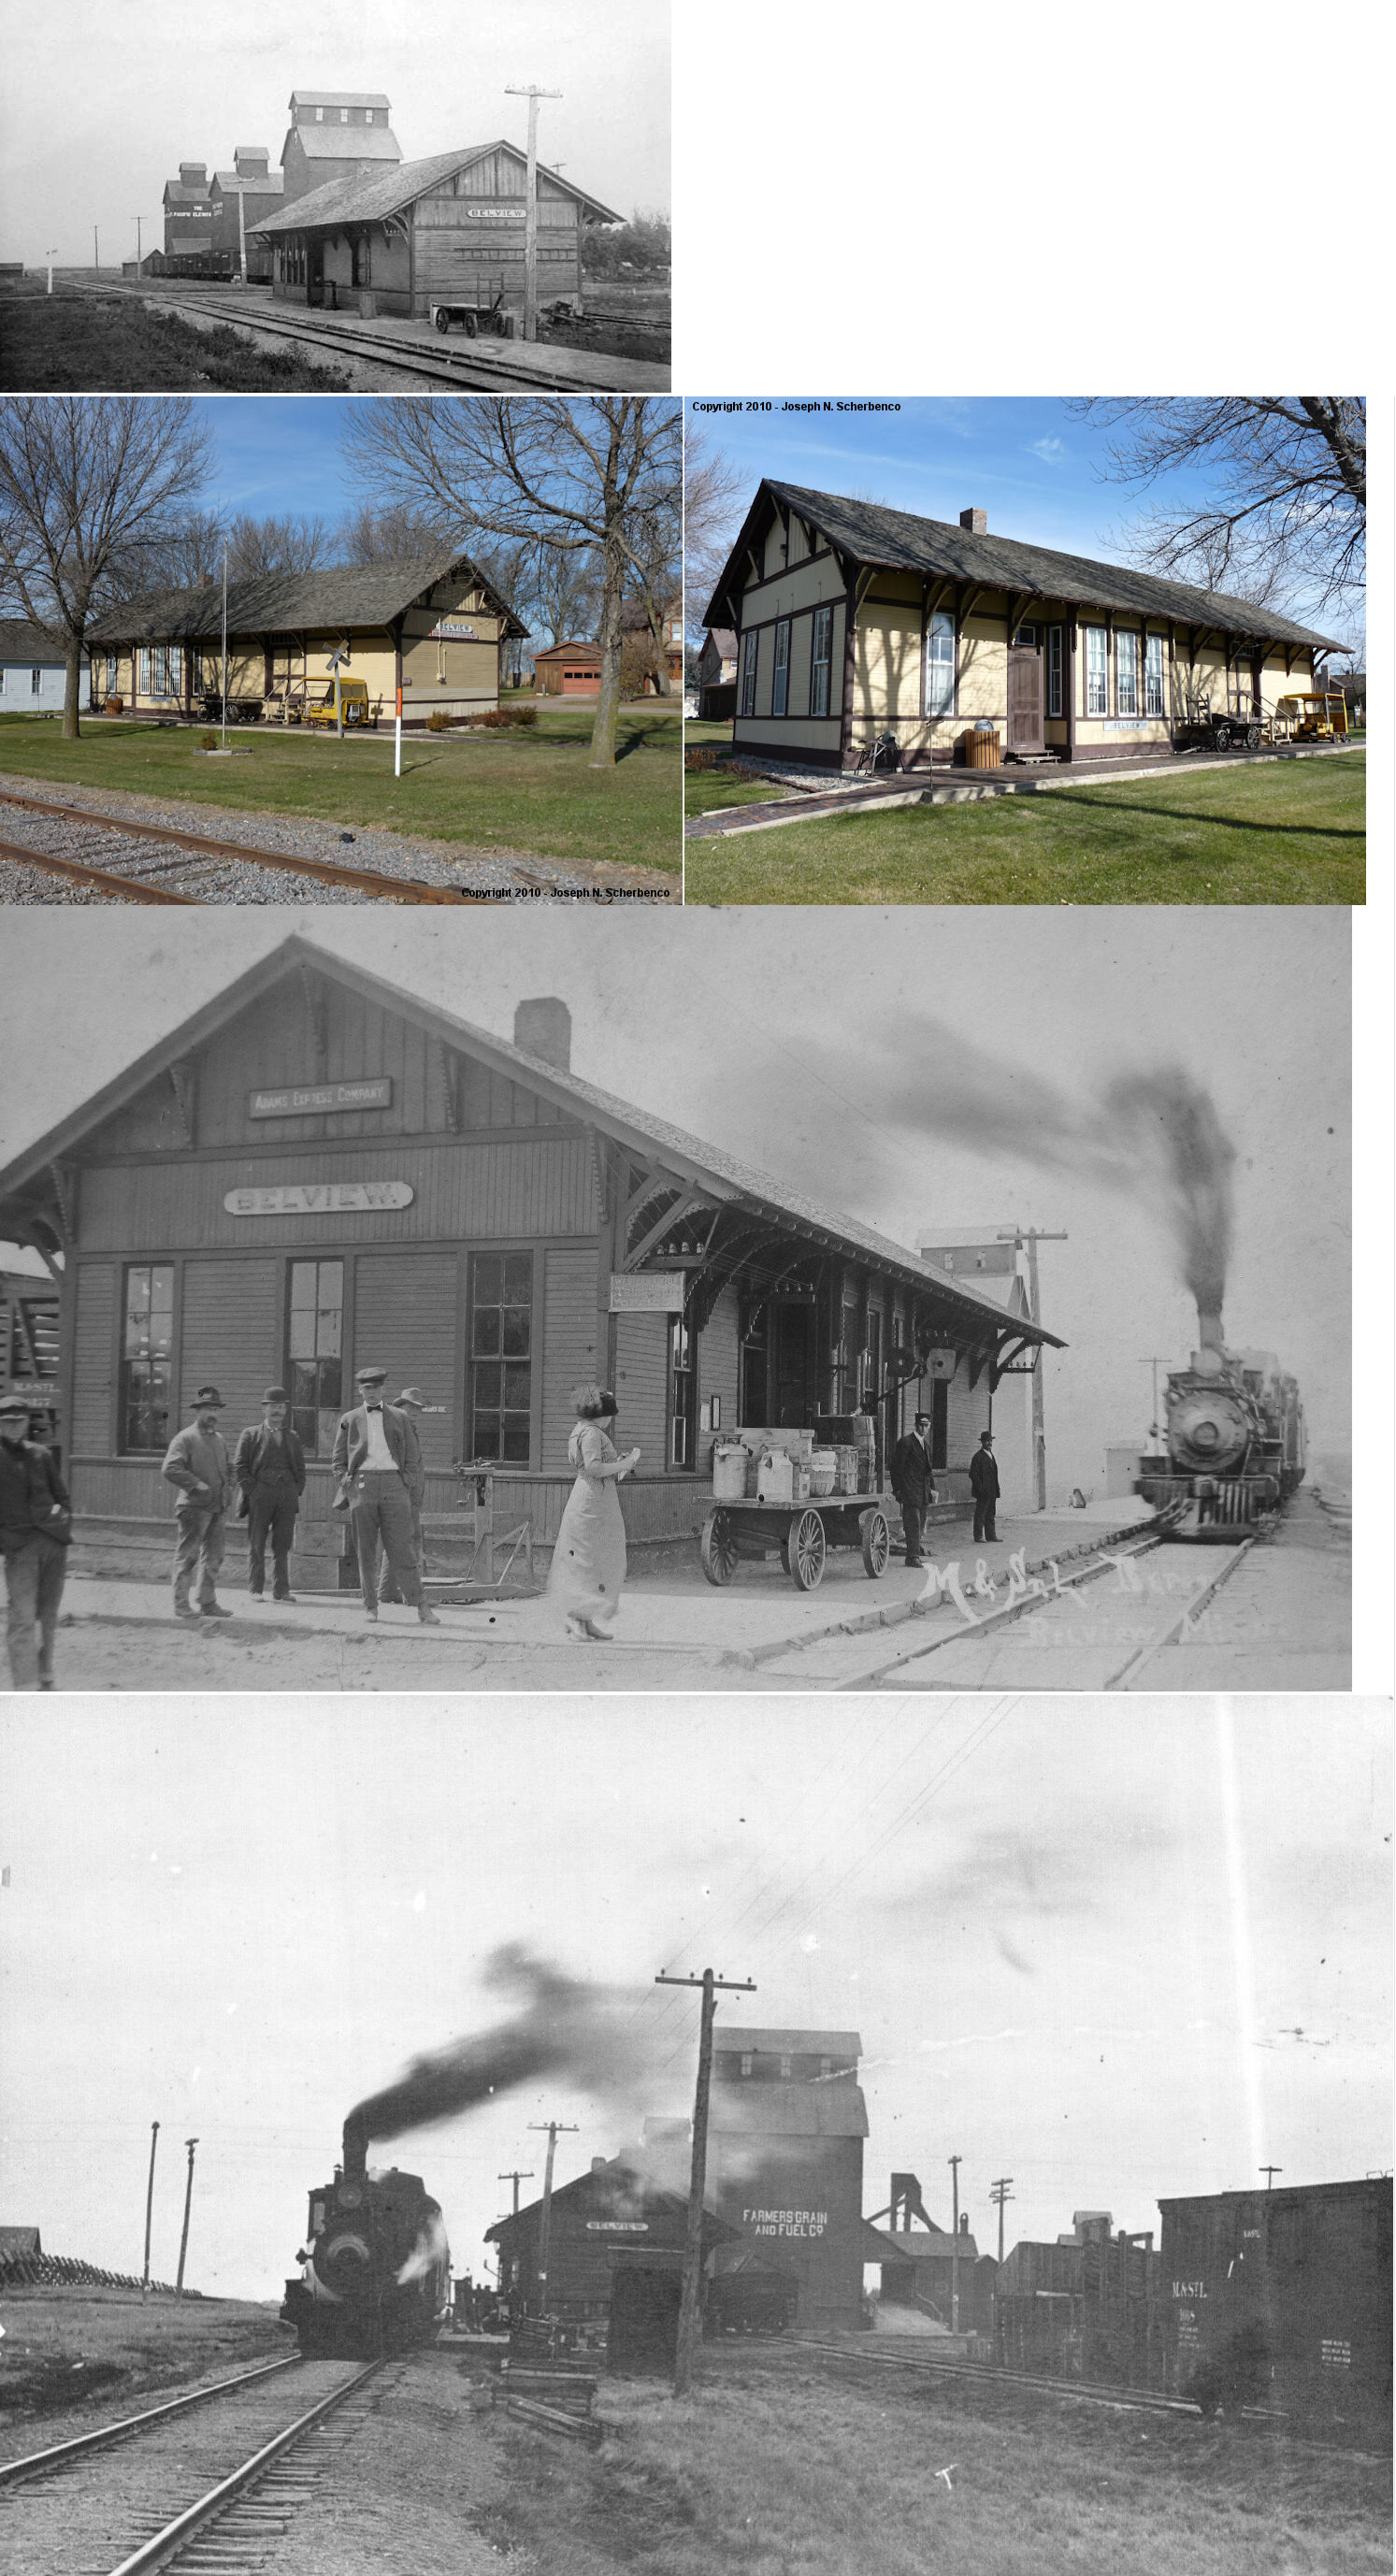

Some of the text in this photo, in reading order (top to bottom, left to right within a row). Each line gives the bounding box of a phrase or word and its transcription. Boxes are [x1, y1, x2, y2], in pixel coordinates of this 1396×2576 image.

[255, 1085, 384, 1110] ADAMS EXPRESS COMPANY
[743, 2209, 828, 2224] FARMERS GRAIN
[756, 2224, 776, 2236] AND
[778, 2223, 807, 2237] FUEL
